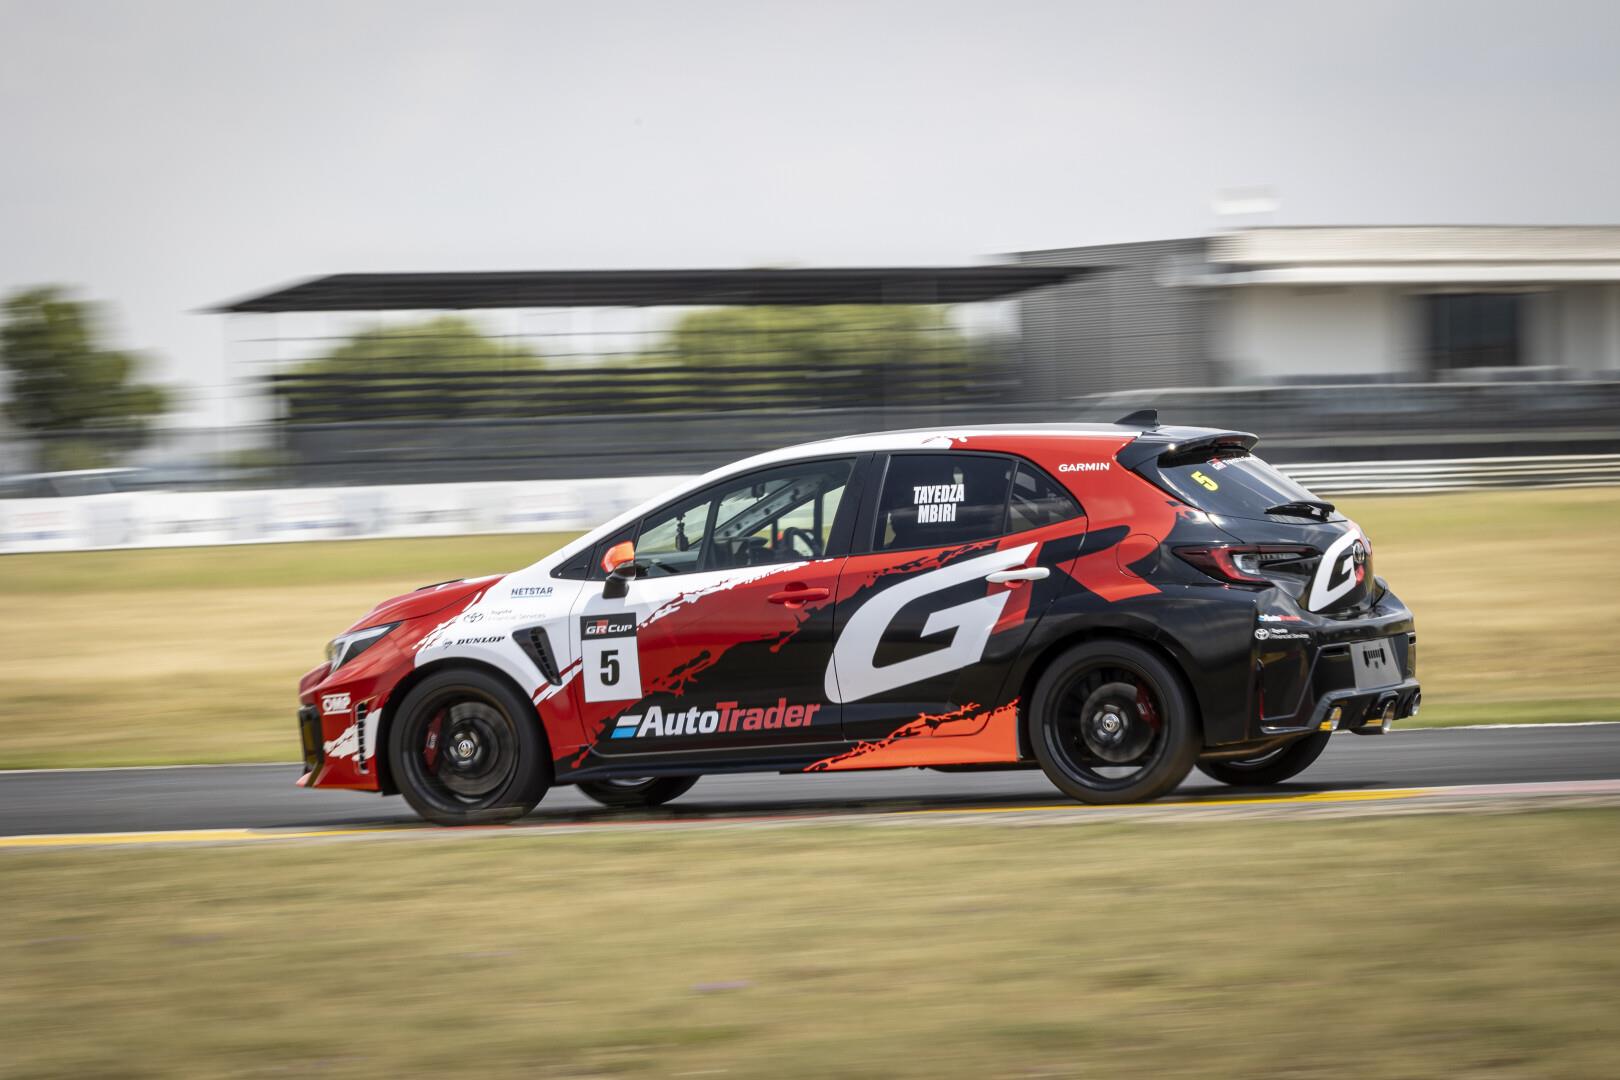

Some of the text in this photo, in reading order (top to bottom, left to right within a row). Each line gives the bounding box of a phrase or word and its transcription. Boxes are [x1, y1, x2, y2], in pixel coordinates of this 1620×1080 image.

[1058, 462, 1110, 473] GARMIN
[1190, 470, 1219, 491] 5
[913, 483, 965, 505] TAYEDZA
[917, 503, 957, 524] MBIRI
[511, 587, 554, 597] NETSTAR
[586, 625, 608, 635] GR
[824, 542, 1039, 704] G
[456, 636, 506, 646] DUNLOP
[600, 649, 621, 686] 5
[636, 697, 821, 738] AutoTrader
